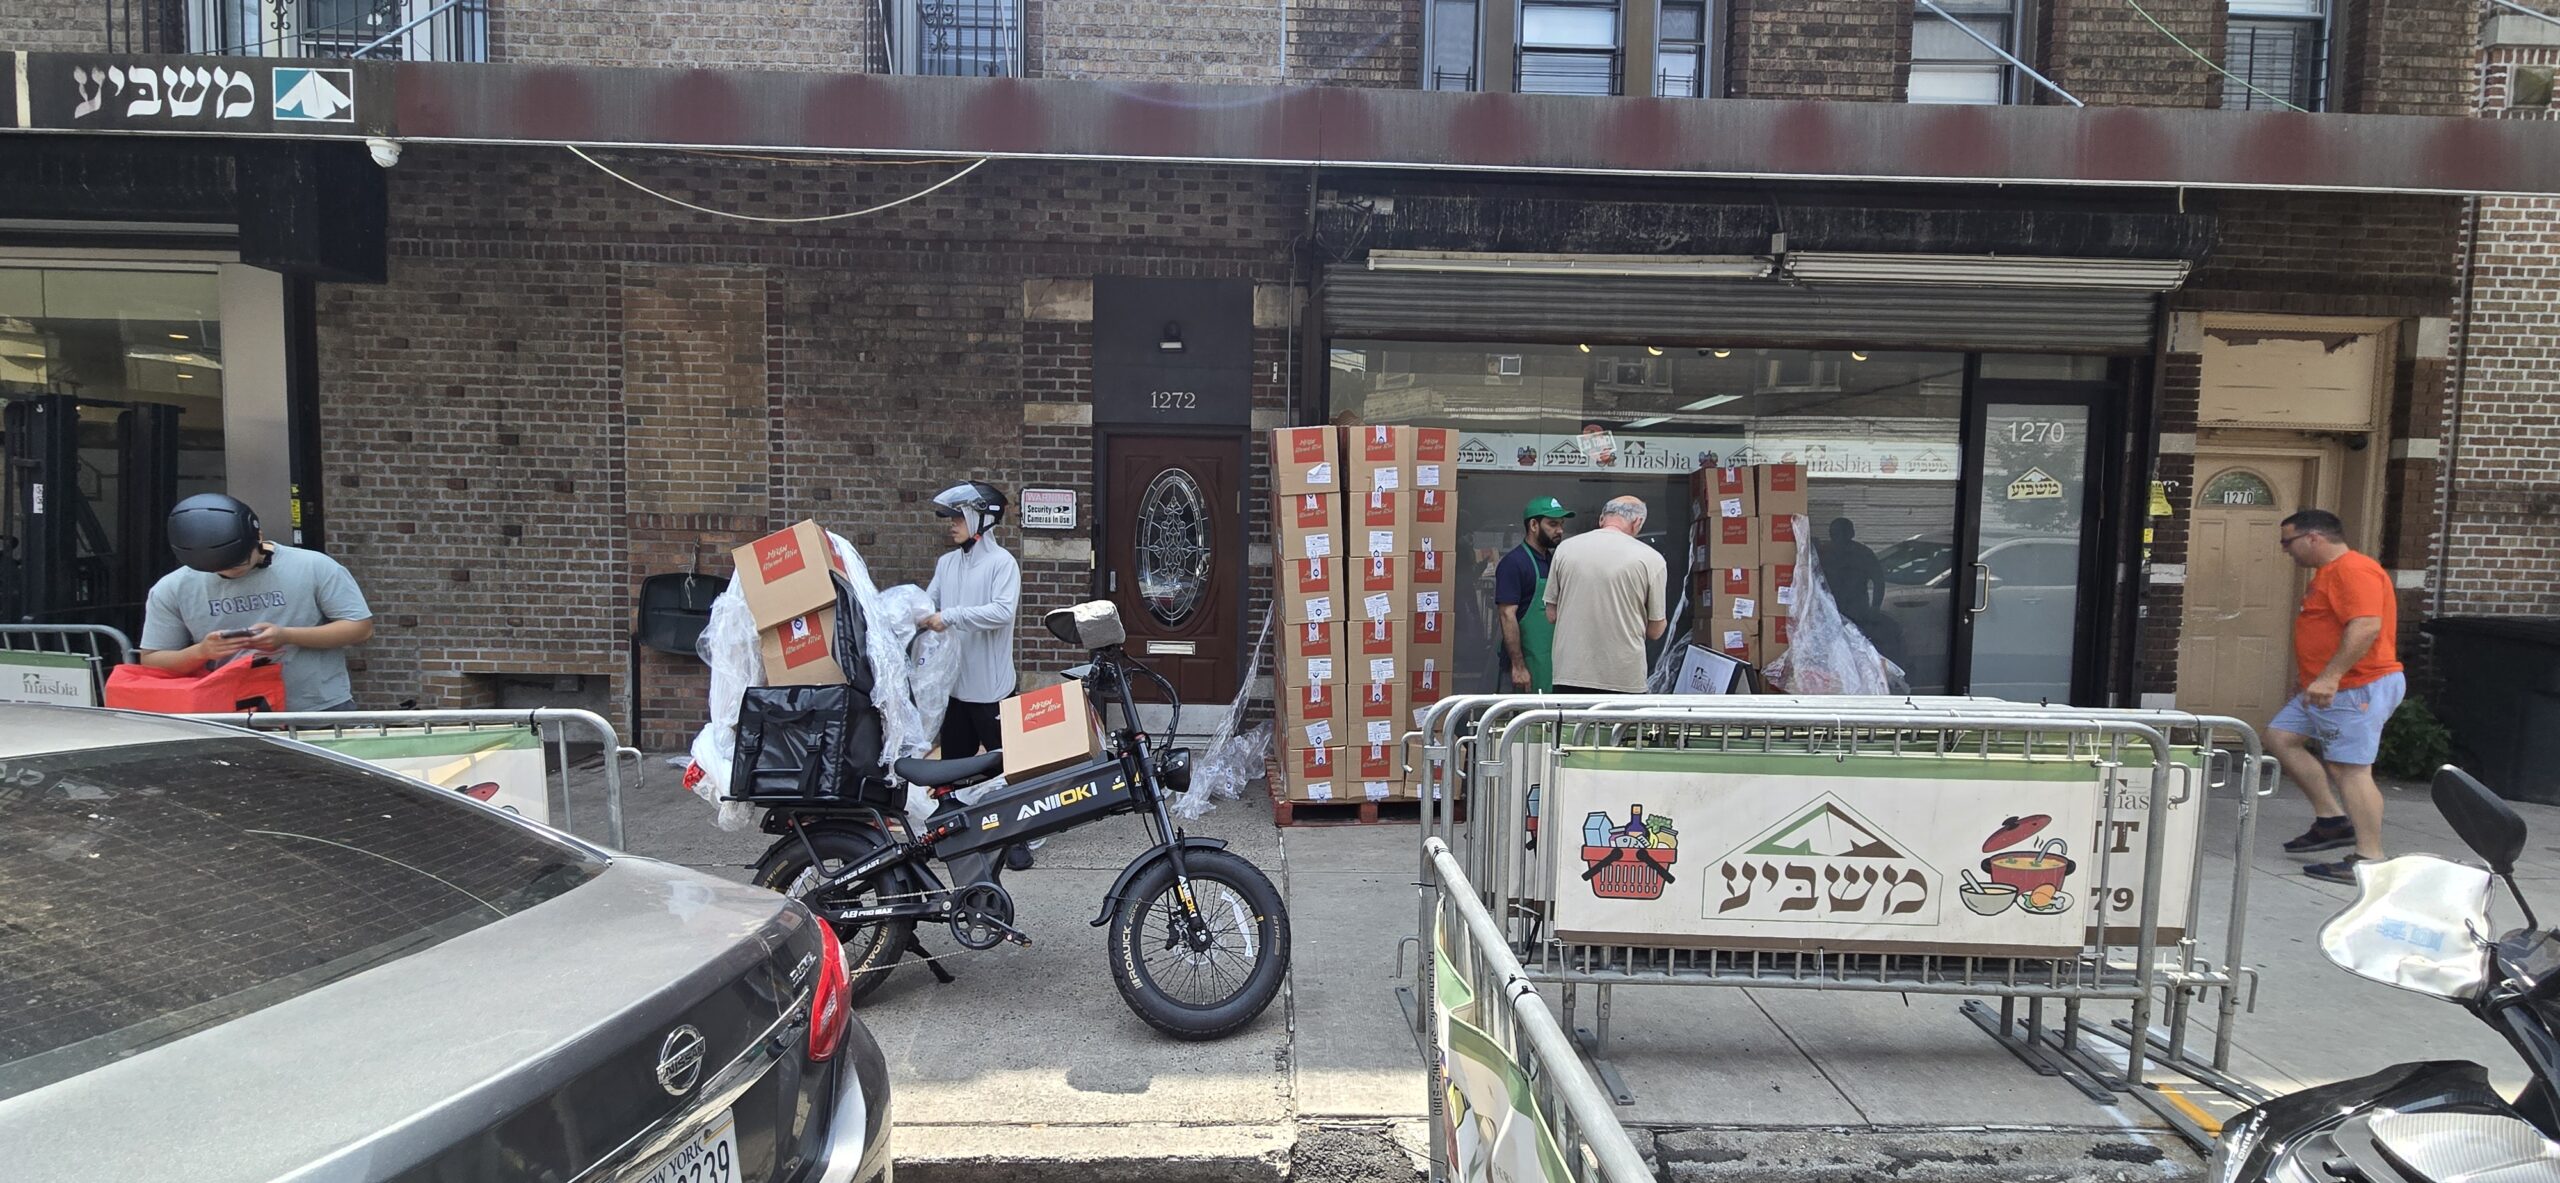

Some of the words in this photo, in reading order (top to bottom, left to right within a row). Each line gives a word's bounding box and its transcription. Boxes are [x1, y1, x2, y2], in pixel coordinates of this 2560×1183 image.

[1151, 391, 1196, 409] 1272
[2008, 422, 2065, 442] 1270
[1625, 450, 1691, 471] masbia
[1026, 493, 1072, 502] WARNING
[2225, 491, 2254, 504] 1270
[1027, 505, 1052, 514] Security
[1027, 514, 1051, 523] Cameras
[24, 681, 79, 697] masbia
[1017, 782, 1098, 821] ANIIOKI
[2102, 794, 2178, 811] masa
[981, 813, 999, 826] A8
[858, 858, 880, 874] BEAST
[840, 910, 858, 919] A8
[858, 909, 875, 917] PRO
[875, 907, 893, 915] MAX
[669, 1136, 704, 1177] YORK
